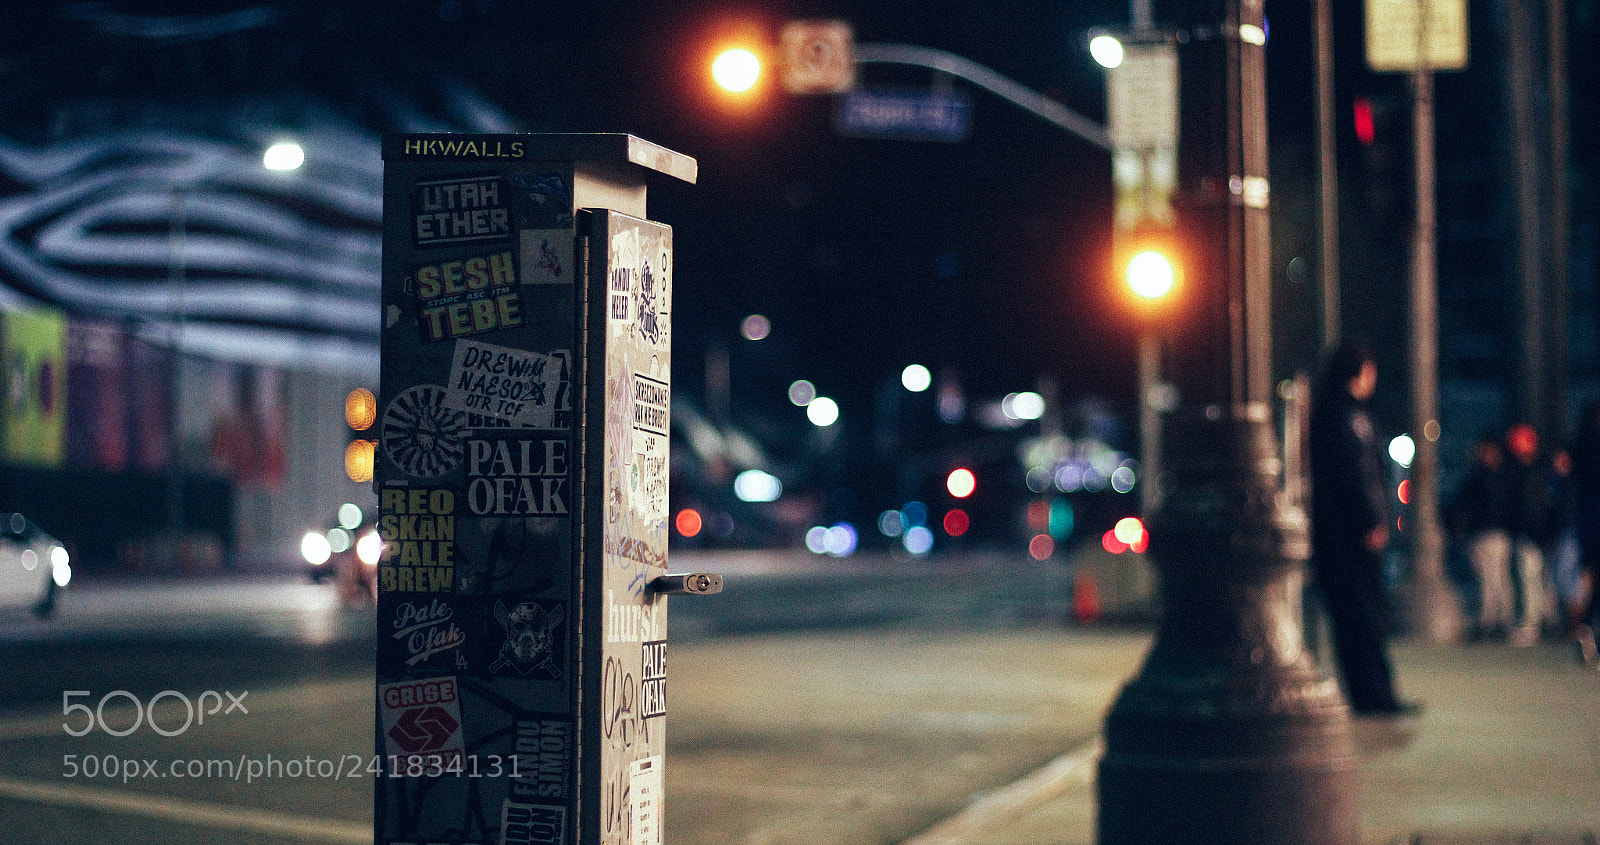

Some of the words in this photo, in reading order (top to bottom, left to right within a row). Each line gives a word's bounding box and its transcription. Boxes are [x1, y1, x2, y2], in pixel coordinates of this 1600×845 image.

[404, 139, 525, 158] HKWALLS
[423, 182, 499, 211] UTAH
[416, 208, 509, 239] ETHER
[417, 251, 516, 298] SESH
[423, 292, 522, 339] TEBE
[467, 439, 568, 476] PALE
[381, 489, 455, 515] REO
[467, 477, 569, 515] OFAK
[381, 514, 454, 540] SKAN
[381, 541, 454, 566] PALE
[381, 566, 453, 592] BREW
[393, 598, 453, 629] Pale
[607, 589, 659, 643] hurst
[408, 622, 464, 657] Ofak
[642, 643, 667, 680] PALE
[384, 679, 455, 709] CRISE
[642, 679, 666, 717] OFAK
[538, 720, 565, 797] SIMON
